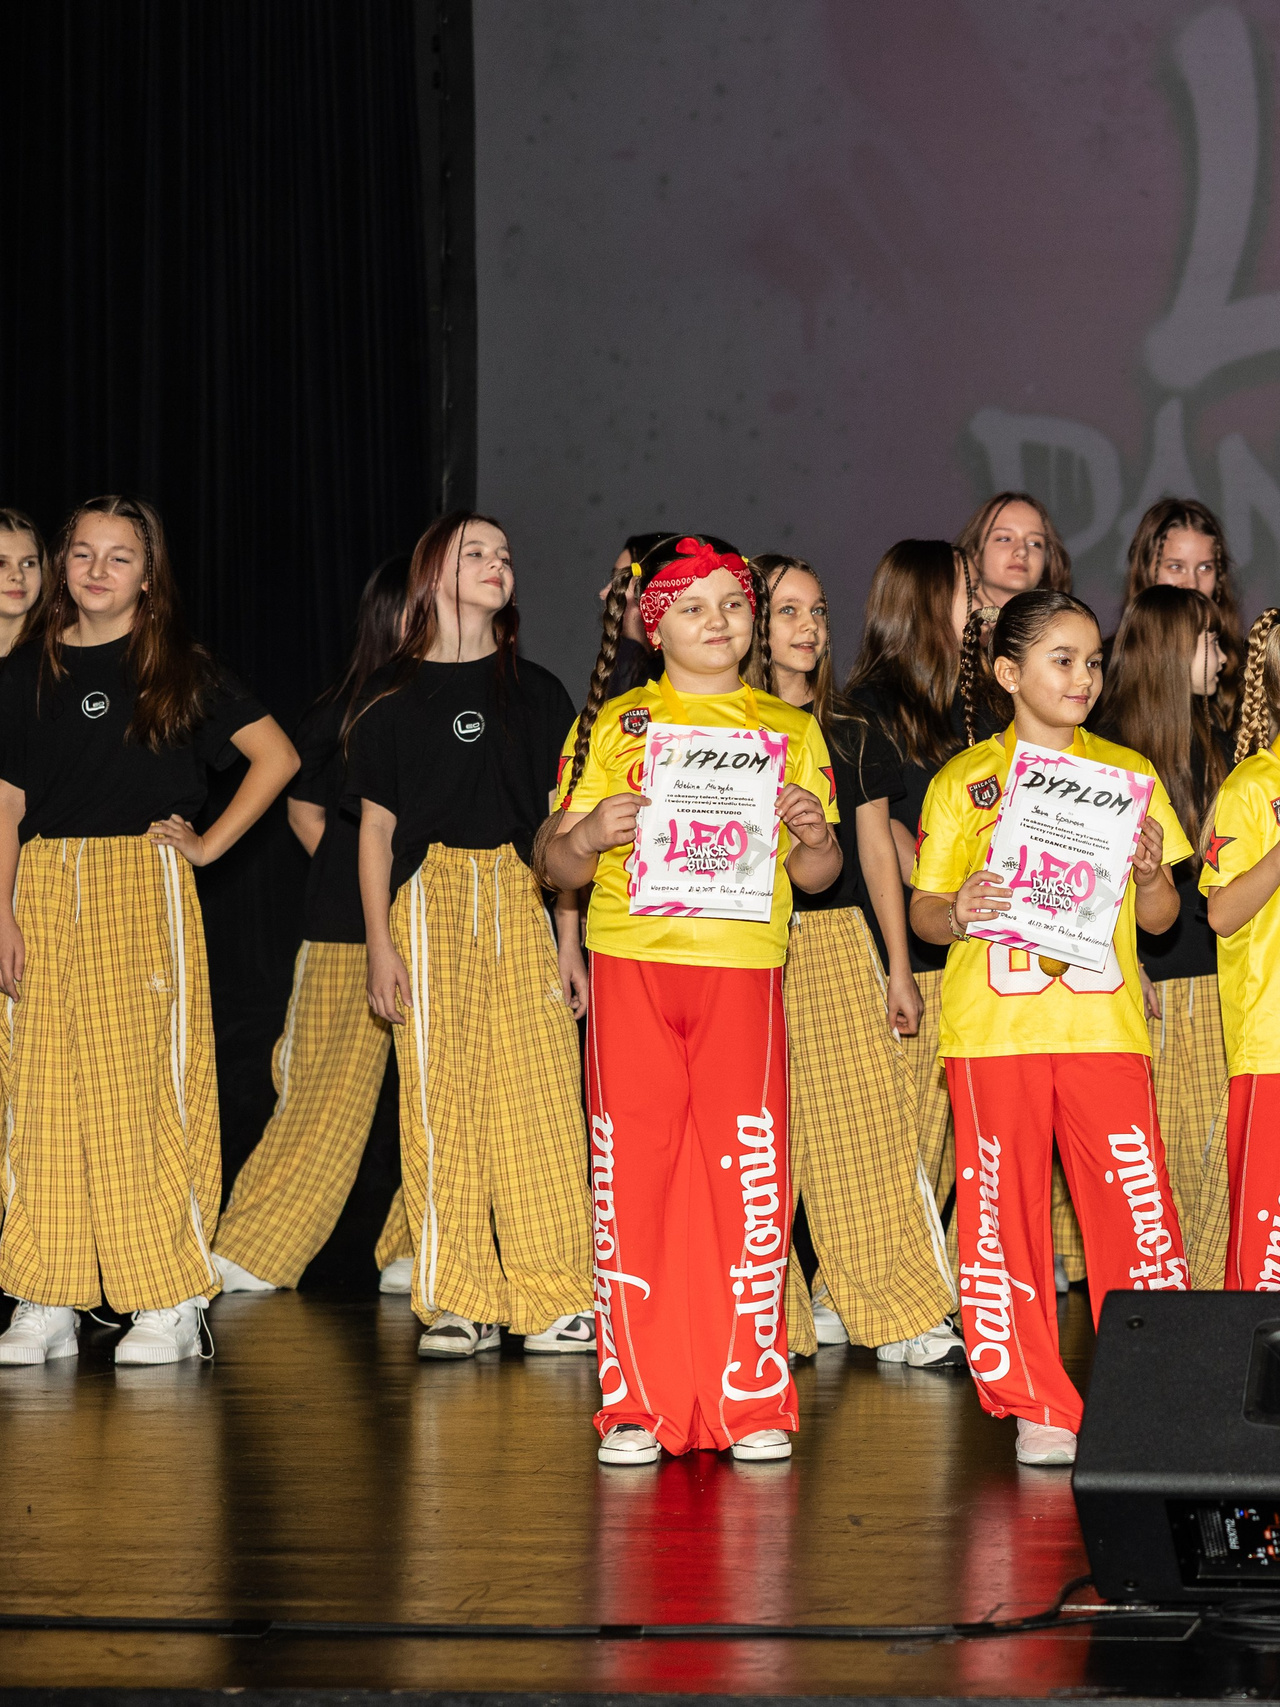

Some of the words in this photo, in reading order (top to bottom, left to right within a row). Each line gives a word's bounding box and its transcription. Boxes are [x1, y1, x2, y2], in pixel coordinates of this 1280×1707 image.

[658, 748, 770, 774] DYPLOM
[969, 776, 996, 791] CHICAGO
[1020, 770, 1133, 816] DYPLOM
[664, 819, 748, 862] LEO
[686, 845, 728, 858] DANCE
[1030, 835, 1044, 843] LEO
[1044, 839, 1067, 849] DANCE
[1068, 845, 1095, 857] STUDIO
[686, 857, 728, 871] STUDIO
[1009, 845, 1096, 904] LEO
[1032, 877, 1074, 897] DANCE
[1030, 892, 1073, 911] STUDIO
[720, 1106, 789, 1401] California
[960, 1134, 1036, 1383] California
